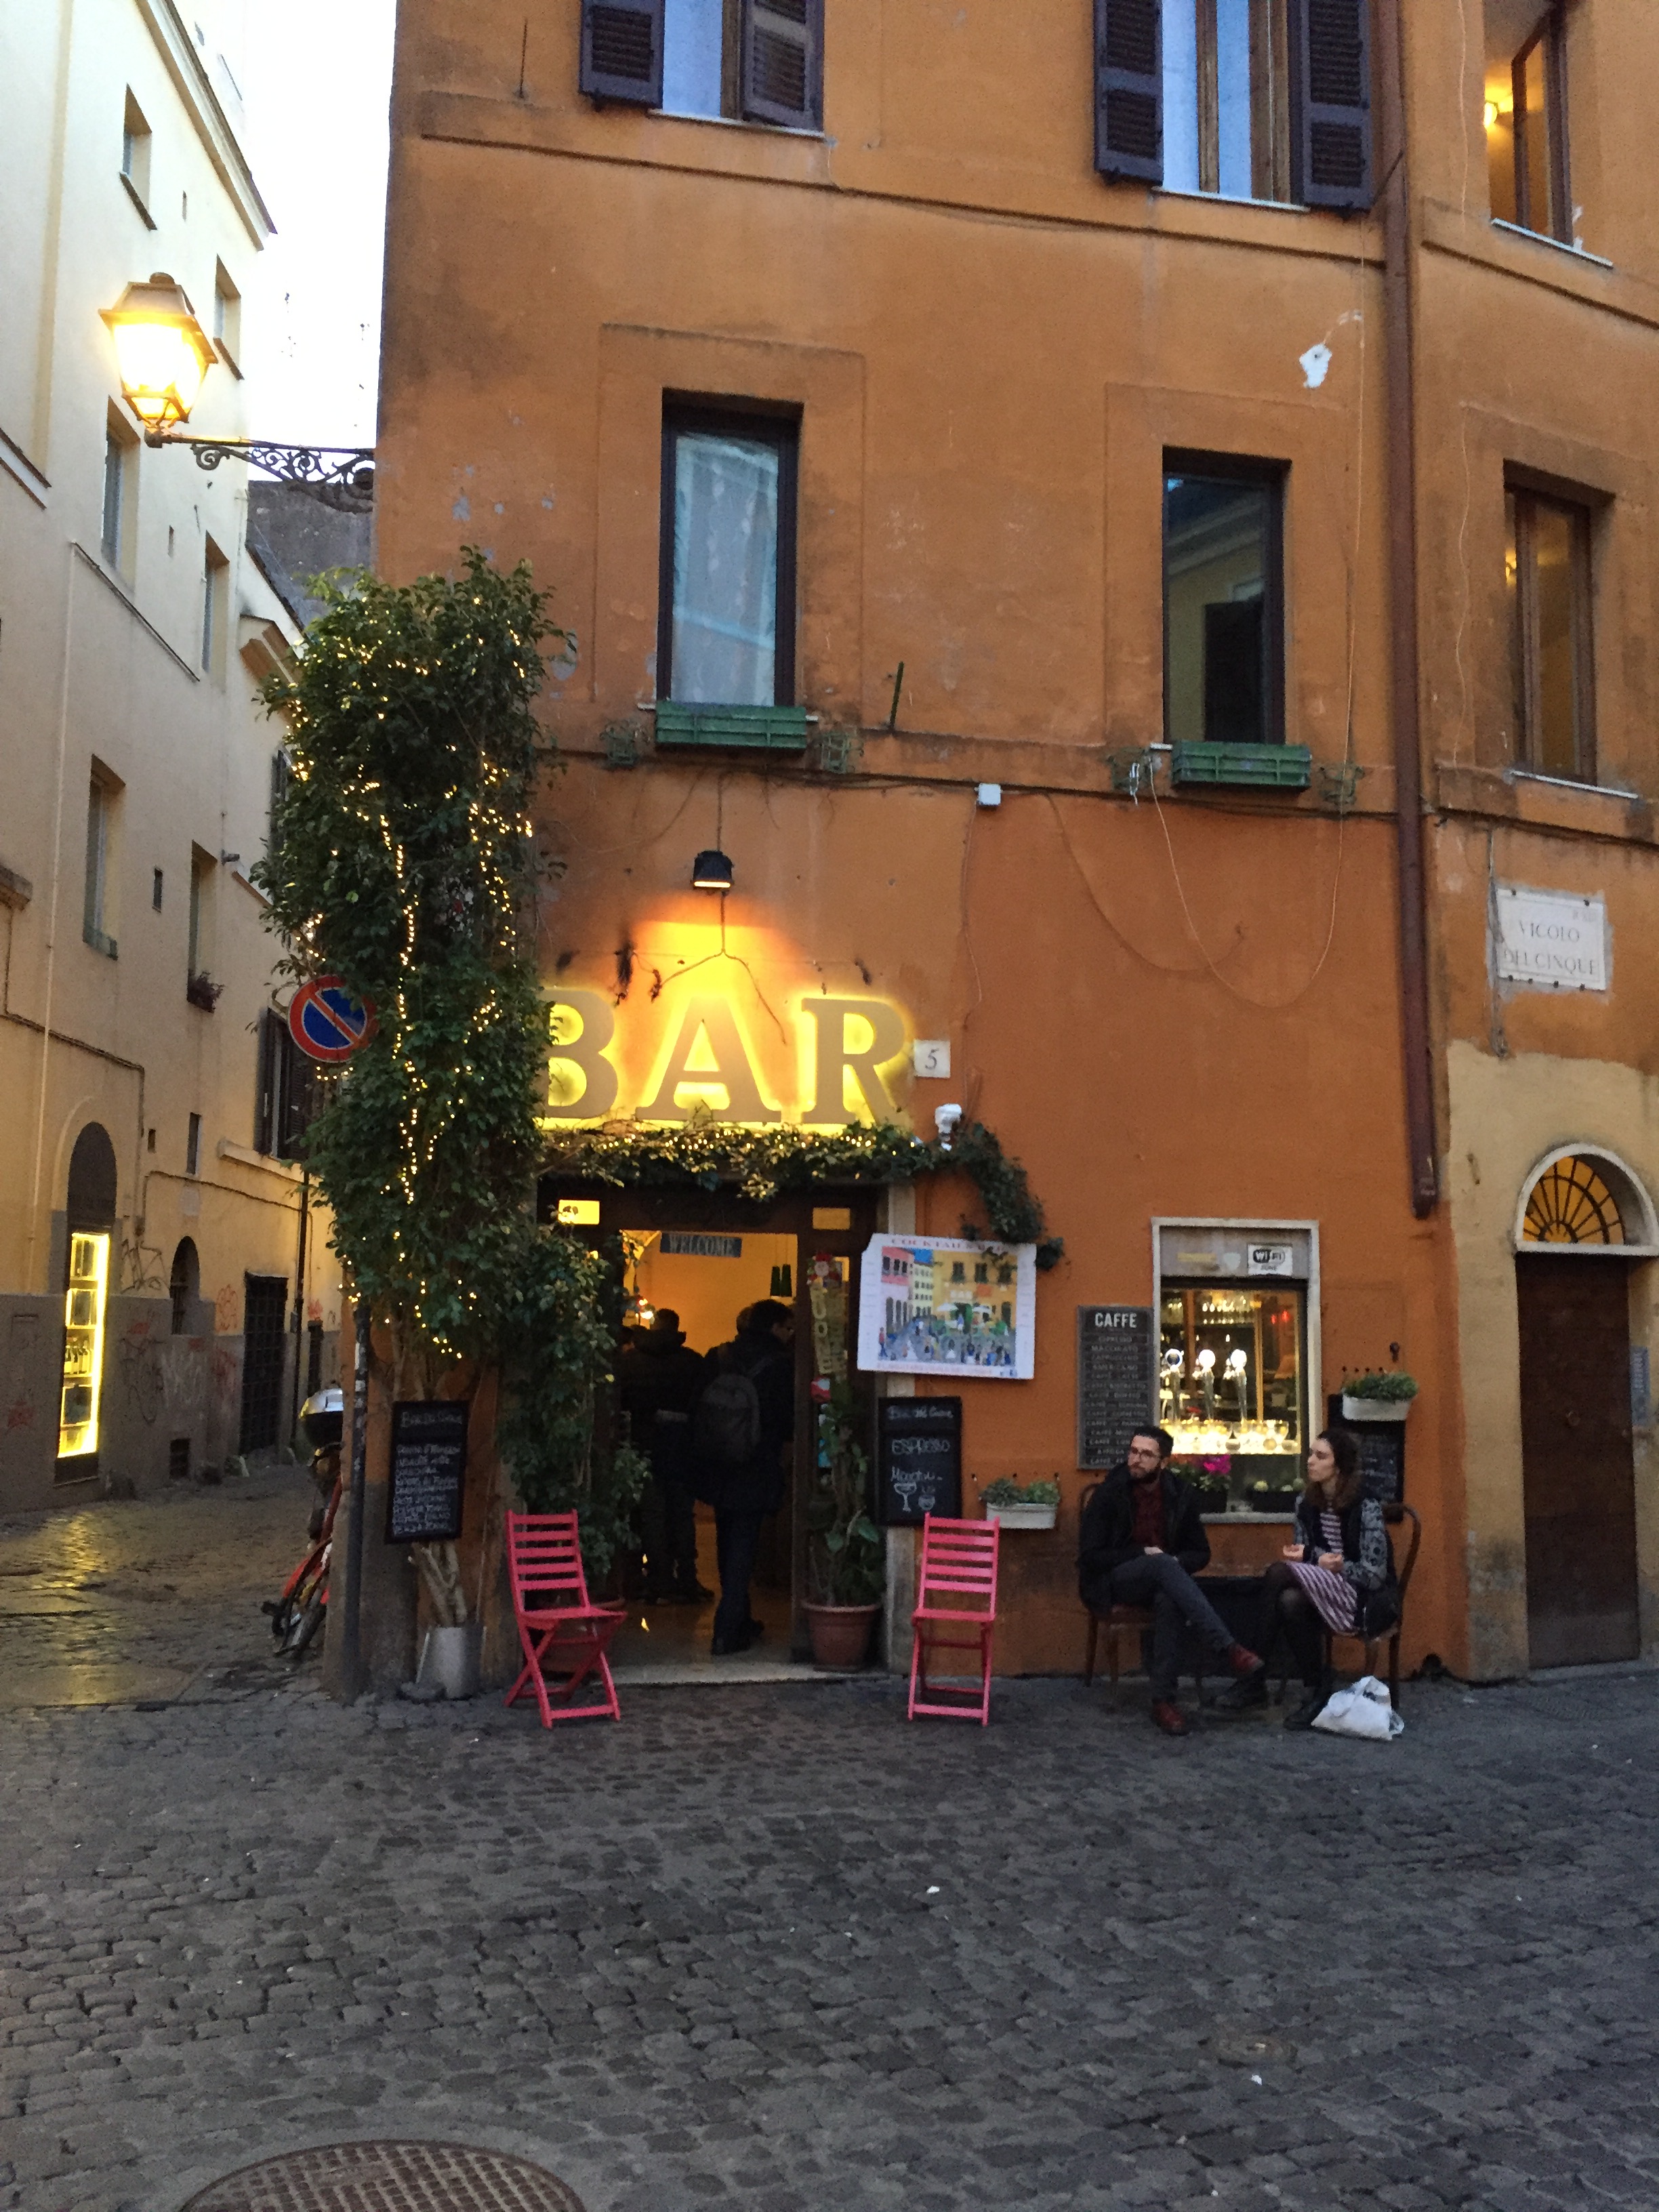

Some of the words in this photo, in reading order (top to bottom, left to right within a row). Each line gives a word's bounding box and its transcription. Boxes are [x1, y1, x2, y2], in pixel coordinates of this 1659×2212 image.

[1518, 920, 1580, 943] VICOLO
[1535, 952, 1595, 975] CINQUE
[542, 987, 912, 1126] BAR
[924, 1048, 939, 1071] 5
[669, 1232, 735, 1257] WELCOME
[1094, 1311, 1138, 1328] CAFFE
